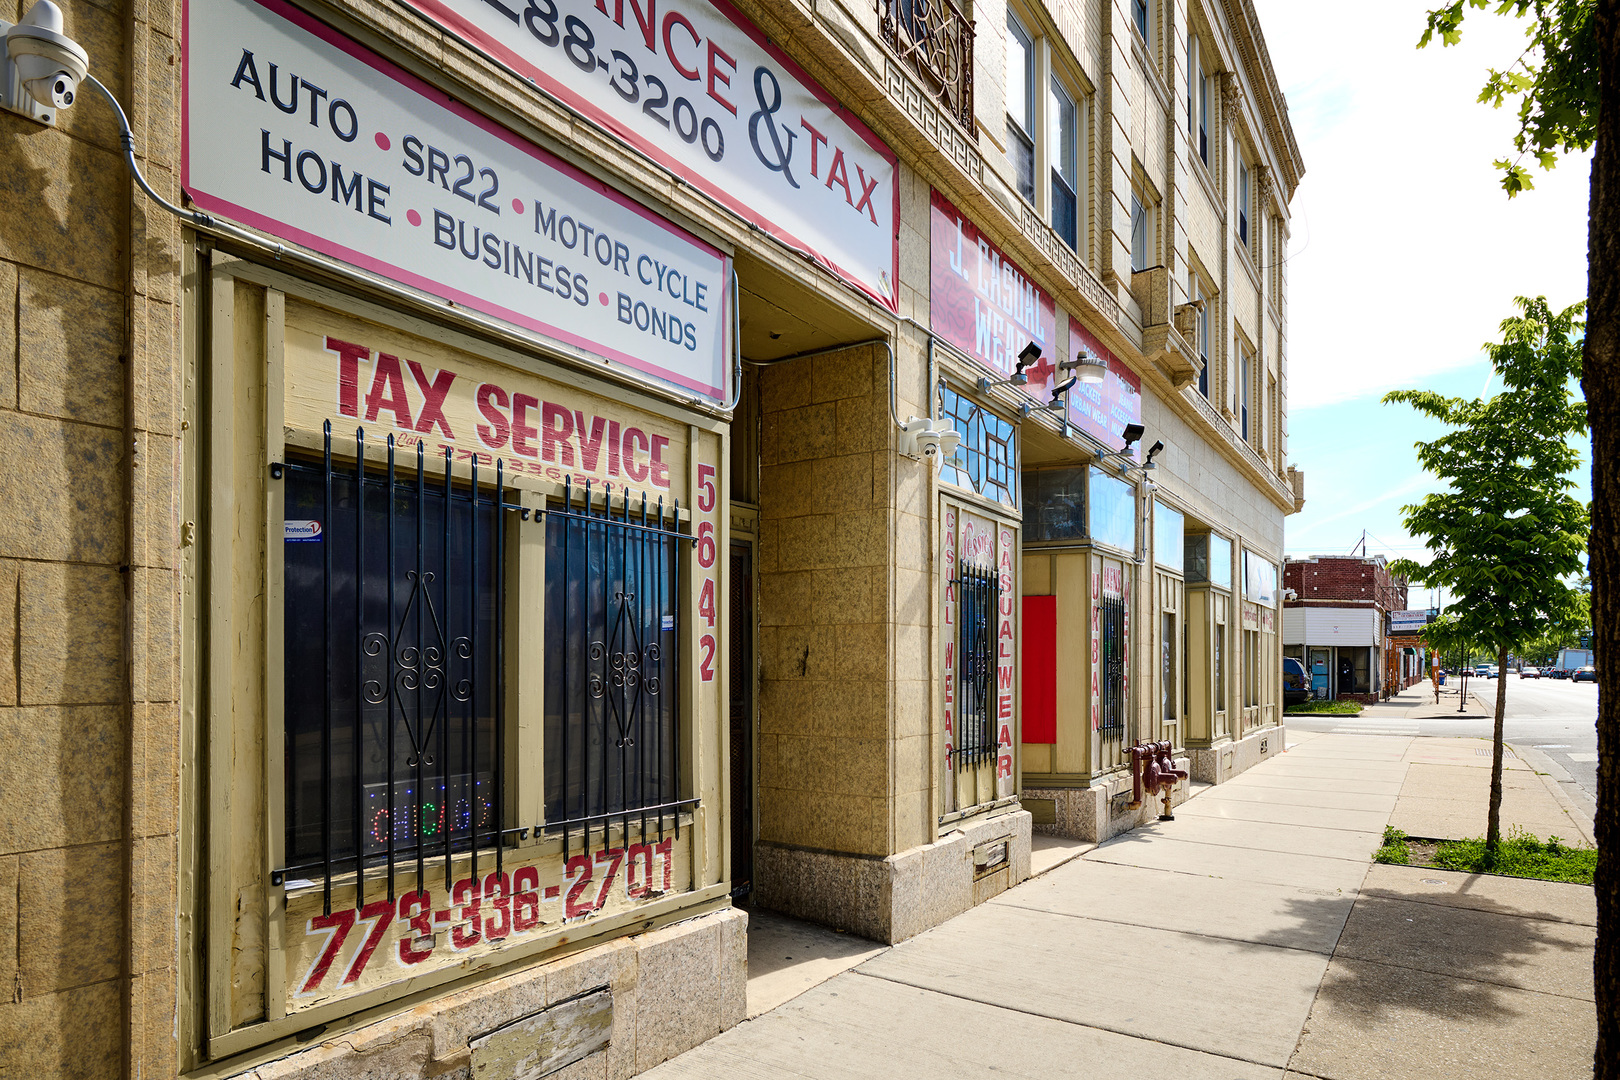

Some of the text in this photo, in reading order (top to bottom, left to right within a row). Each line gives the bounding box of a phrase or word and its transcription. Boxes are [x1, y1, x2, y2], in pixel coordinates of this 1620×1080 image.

[481, 0, 725, 163] 88-3200
[594, 0, 879, 228] NCE & TAX
[230, 48, 708, 313] AUTO SR22 MOTOR CYCLE
[260, 128, 697, 352] HOME BUSINESS BONDS
[949, 216, 1045, 344] J. CASUAL
[323, 335, 671, 490] TAX SERVICE
[1070, 392, 1108, 430] URBAN WEAR
[1078, 381, 1101, 408] JACKETS
[1110, 404, 1138, 425] ACCESSO
[1118, 392, 1134, 413] JEANS
[697, 463, 717, 683] 5642
[945, 512, 955, 625] CASUAL
[961, 521, 994, 560] Jessie's
[998, 530, 1013, 658] CASUAL
[945, 642, 954, 770] WEAR
[1092, 573, 1100, 732] URBAN
[997, 665, 1013, 779] WEAR
[293, 836, 673, 998] 773-336-2701
